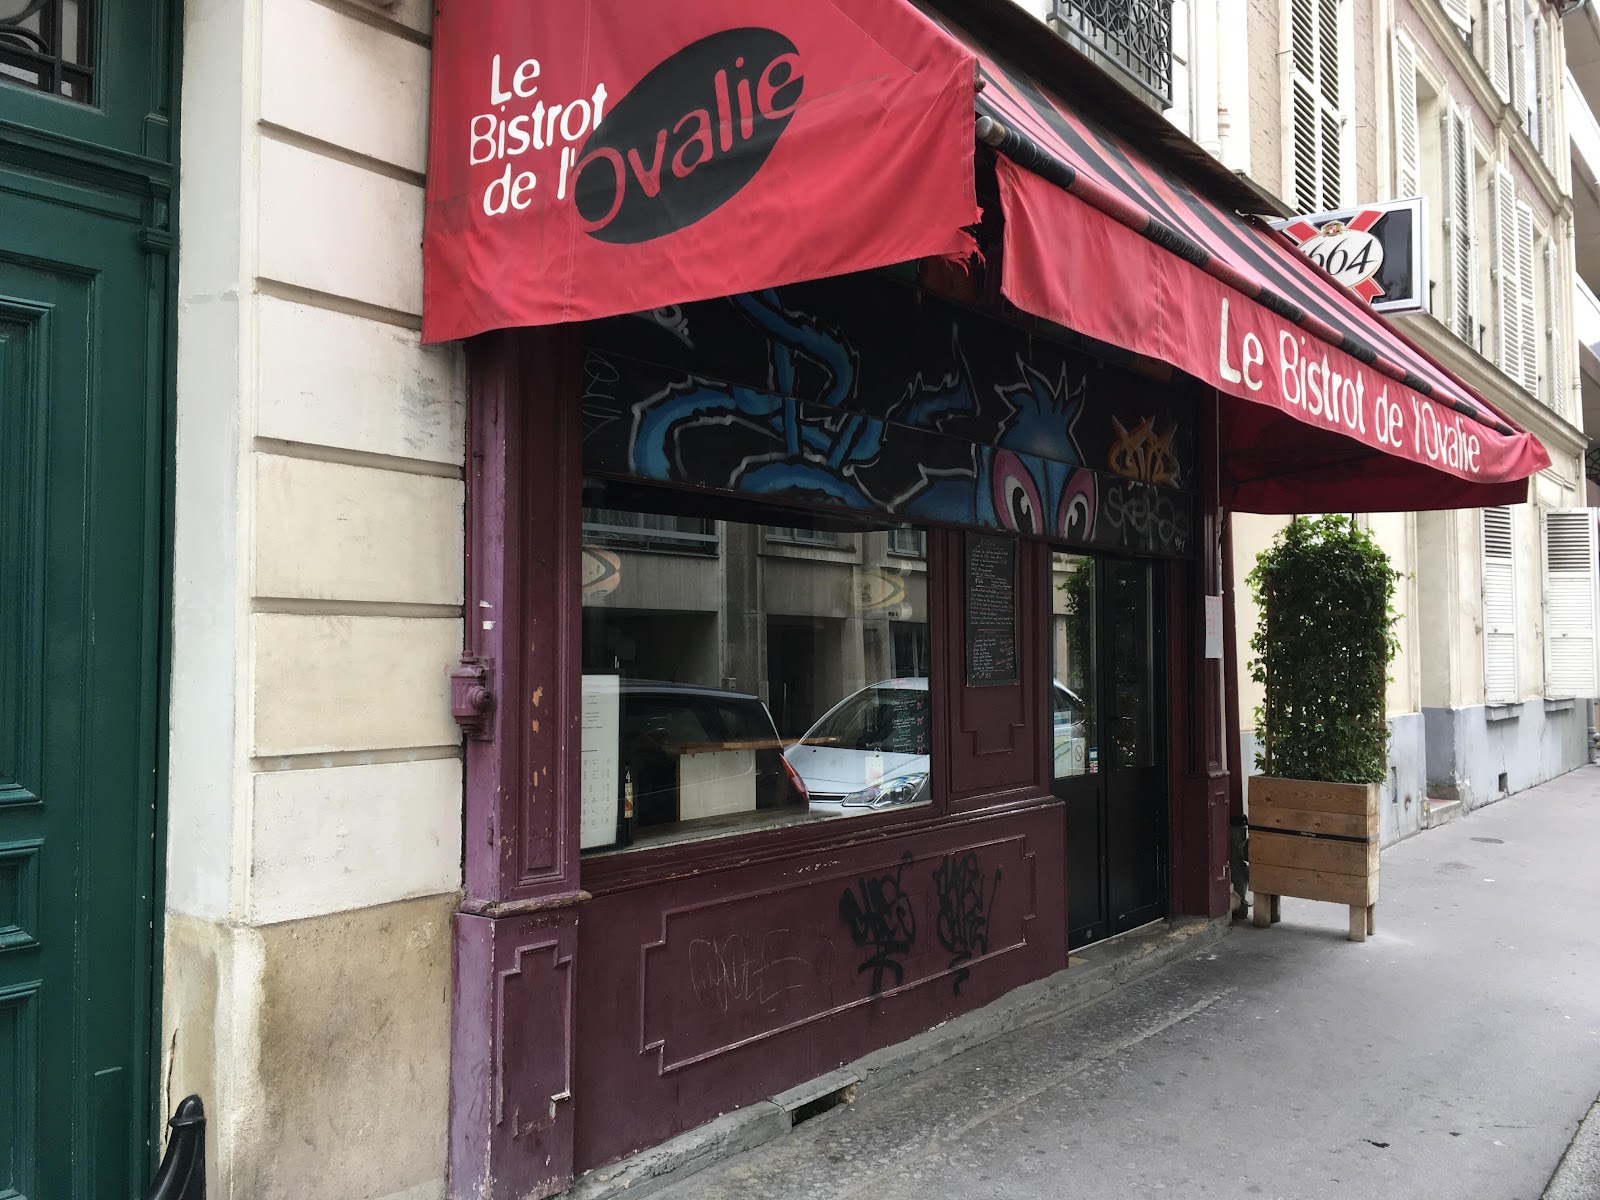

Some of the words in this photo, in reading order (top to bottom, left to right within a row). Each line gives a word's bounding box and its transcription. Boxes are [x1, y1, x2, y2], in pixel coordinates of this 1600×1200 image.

[491, 54, 541, 105] Le
[470, 83, 608, 166] Bistrot
[483, 164, 536, 217] de
[1219, 297, 1265, 391] Le
[1279, 329, 1366, 435] Bistrot
[1374, 384, 1403, 448] de
